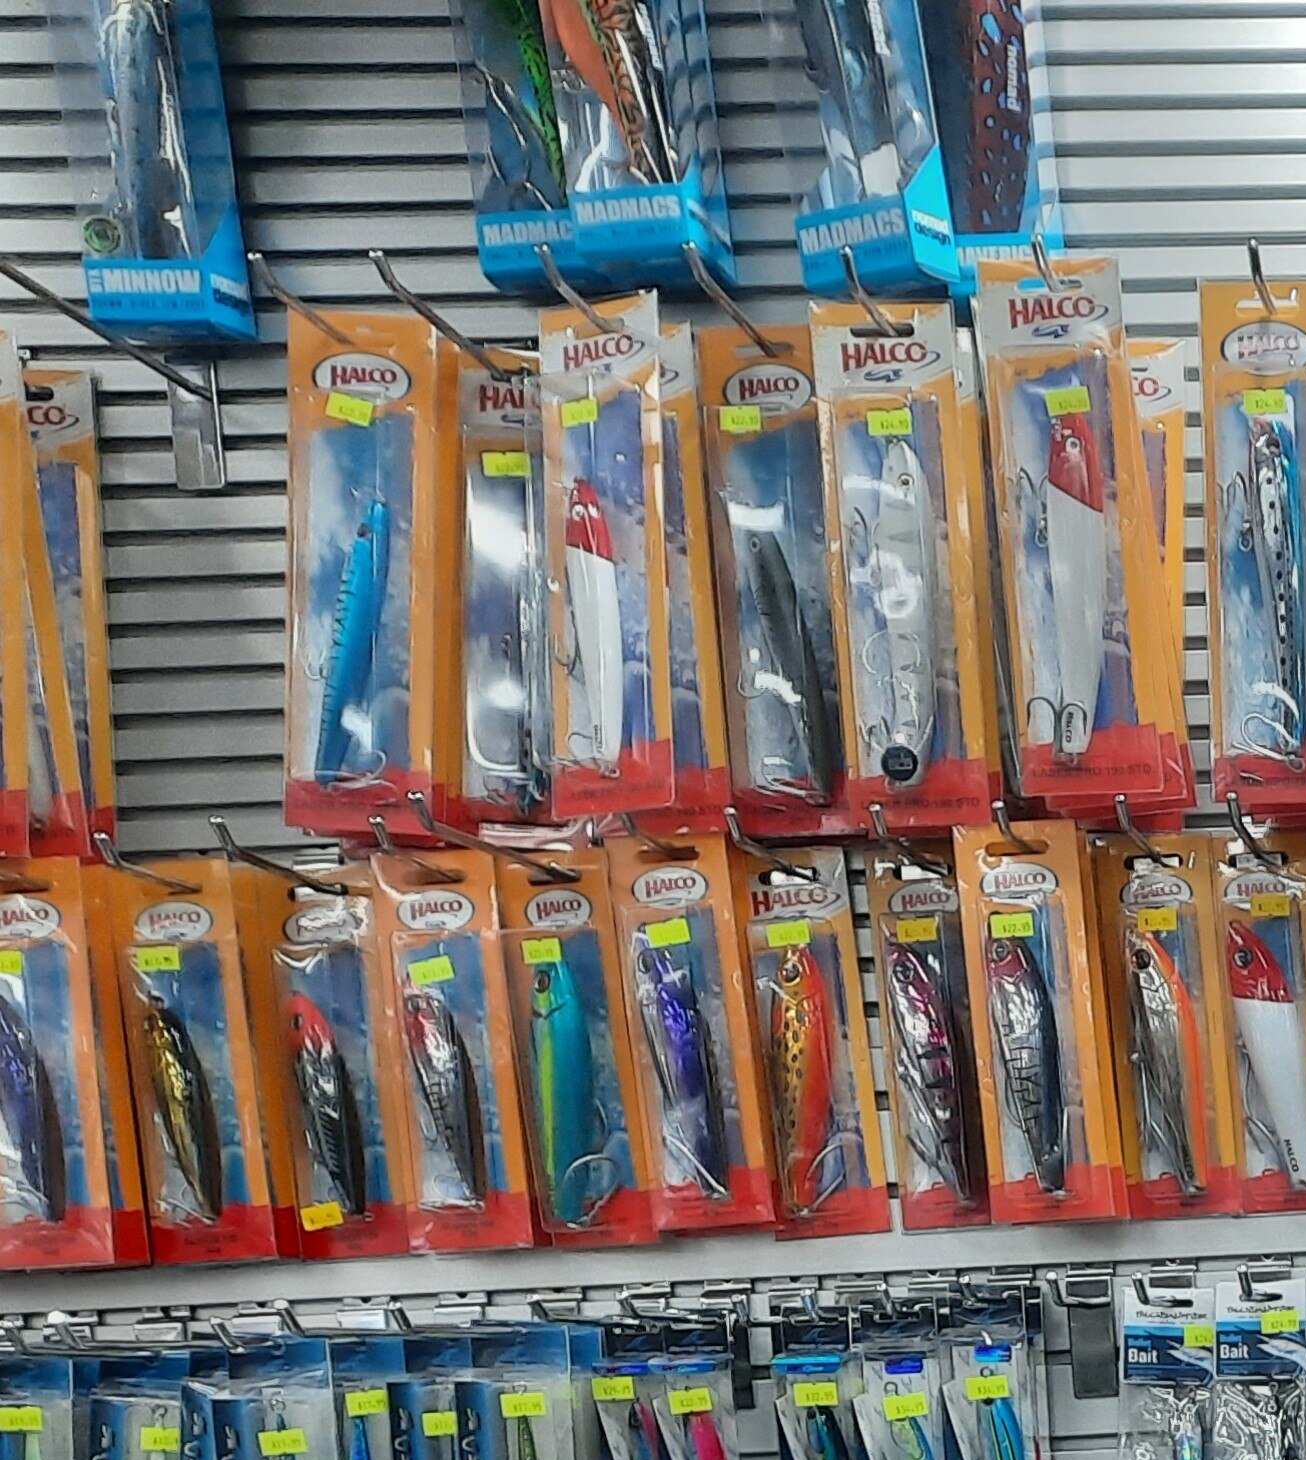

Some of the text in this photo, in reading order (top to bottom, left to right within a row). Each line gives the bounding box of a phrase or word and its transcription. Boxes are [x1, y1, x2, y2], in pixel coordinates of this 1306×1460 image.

[1005, 45, 1023, 113] nomad
[578, 195, 680, 224] MADMACS
[484, 221, 572, 246] MADMAC
[800, 208, 902, 253] MADMACS
[102, 268, 201, 294] MINNOW
[1008, 298, 1096, 328] HALCO
[563, 335, 634, 370] HALCO
[841, 342, 928, 371] HALCO
[331, 365, 397, 387] HALCO
[738, 376, 800, 400] HALCO
[645, 874, 697, 895] HALCO
[993, 870, 1046, 891] HALCO
[1236, 881, 1285, 896] HALCO
[411, 900, 462, 919] HALCO
[534, 899, 582, 919] HALCO
[752, 888, 830, 917] HALCO
[901, 893, 950, 912] HALCO
[1283, 1138, 1300, 1173] HALCO
[1128, 1349, 1158, 1363] Bait
[1220, 1345, 1249, 1359] Bait
